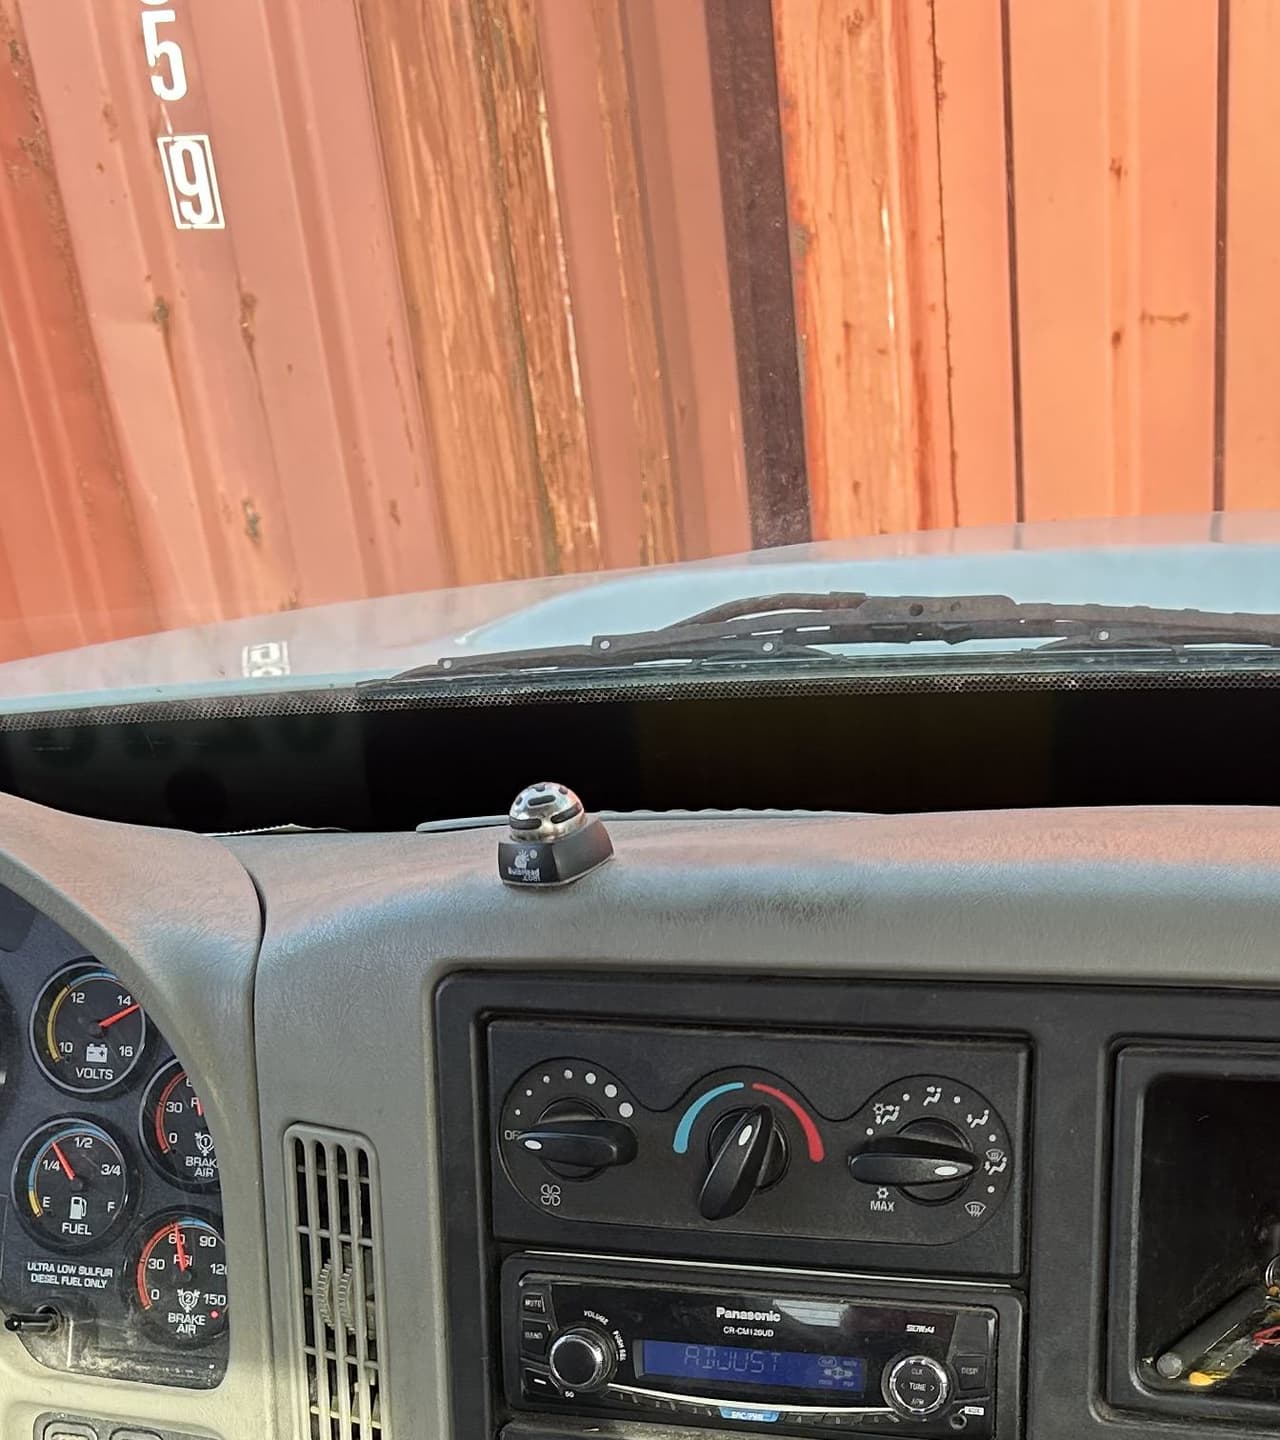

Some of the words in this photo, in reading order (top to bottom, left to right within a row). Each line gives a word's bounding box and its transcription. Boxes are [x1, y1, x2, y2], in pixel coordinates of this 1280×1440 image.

[141, 9, 188, 101] 5
[168, 138, 216, 226] 9
[70, 992, 85, 1004] 12
[117, 995, 132, 1006] 14
[59, 1042, 73, 1053] 10
[118, 1045, 134, 1057] 16
[75, 1067, 114, 1080] VOLTS
[166, 1101, 183, 1113] 30
[74, 1137, 93, 1149] 1/2
[169, 1133, 178, 1144] 0
[42, 1159, 61, 1171] 1/4
[185, 1156, 219, 1168] BRAK
[101, 1164, 121, 1177] 3/4
[194, 1168, 214, 1178] AIR
[42, 1196, 51, 1208] E
[107, 1201, 116, 1213] F
[870, 1200, 895, 1212] MAX
[62, 1222, 92, 1235] FUEL
[199, 1236, 217, 1248] 90
[27, 1262, 55, 1272] ULTRA
[57, 1264, 76, 1274] LOW
[78, 1266, 113, 1278] SULFUR
[148, 1258, 165, 1270] 30
[30, 1273, 60, 1285] DIESEL
[61, 1276, 83, 1287] FUEL
[83, 1277, 108, 1289] ONLY
[151, 1289, 160, 1300] 0
[203, 1293, 227, 1306] 150
[168, 1312, 206, 1326] BRAKE
[584, 1310, 610, 1326] VOLUME
[716, 1306, 782, 1322] Panasonic
[176, 1324, 197, 1335] AIR
[684, 1345, 781, 1373] ADJUST
[909, 1382, 927, 1392] TUNE
